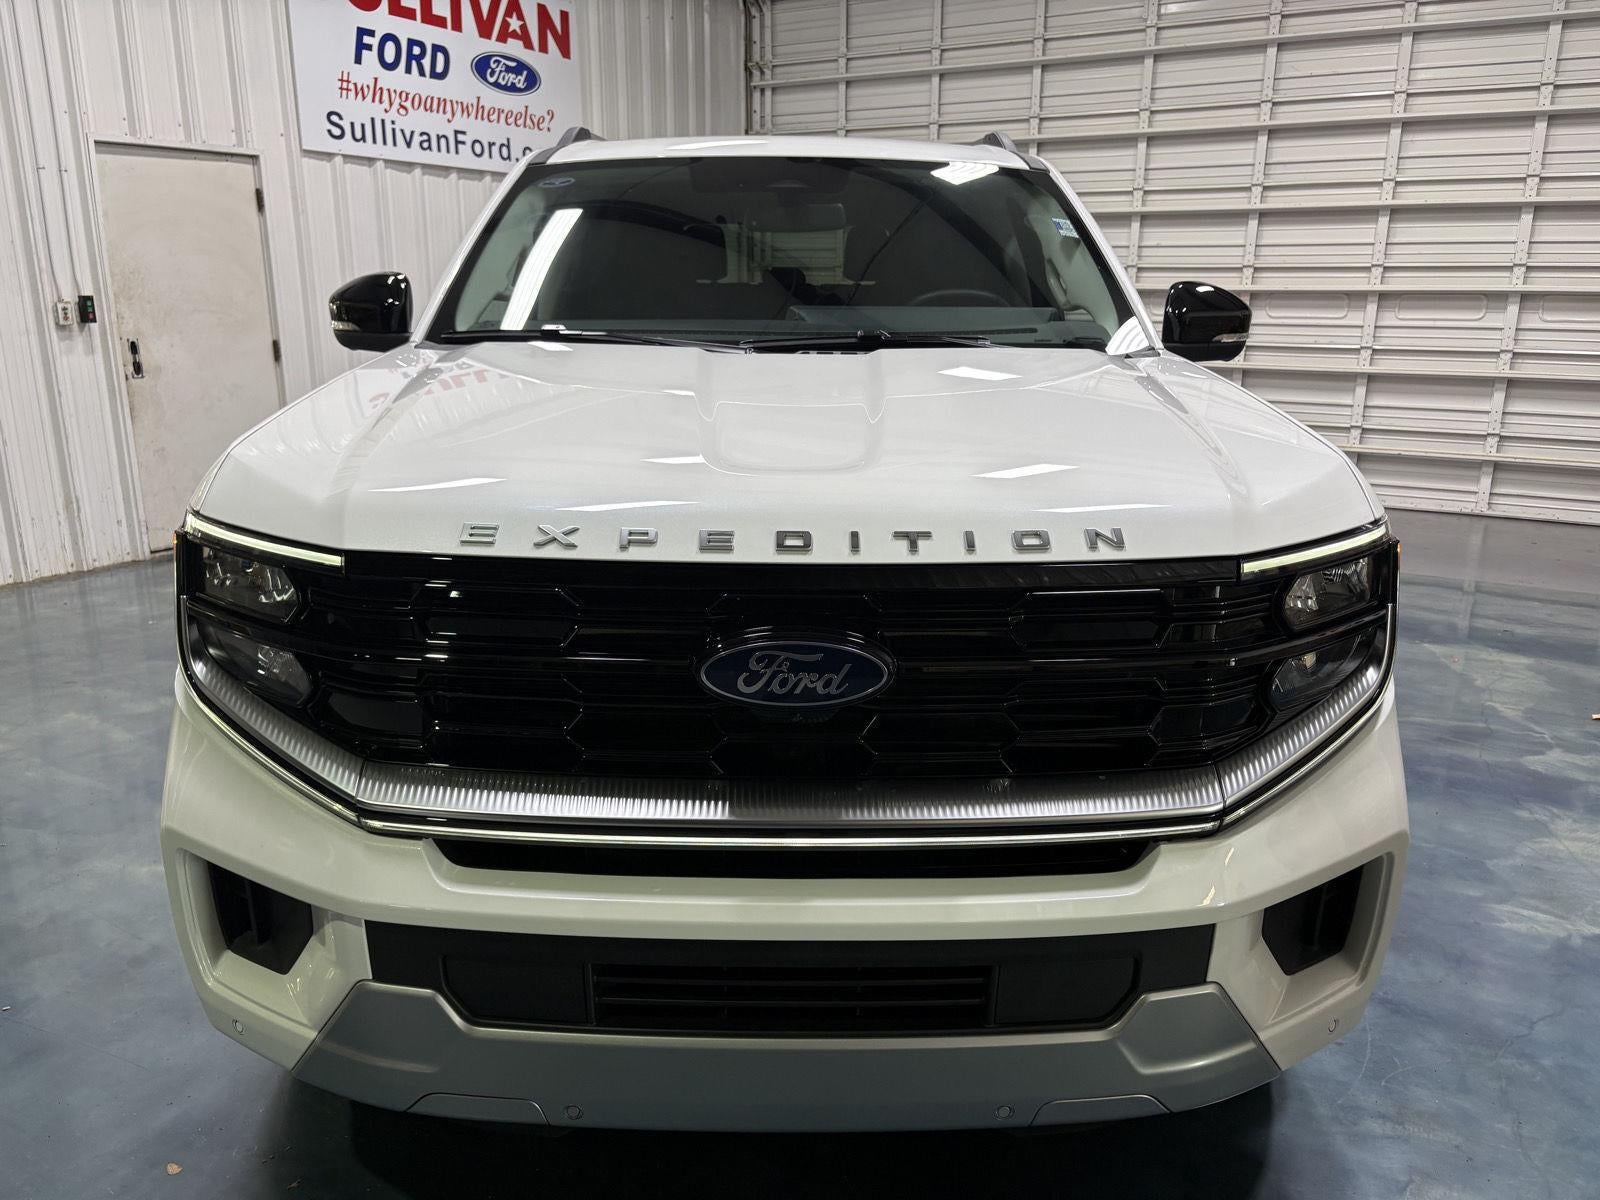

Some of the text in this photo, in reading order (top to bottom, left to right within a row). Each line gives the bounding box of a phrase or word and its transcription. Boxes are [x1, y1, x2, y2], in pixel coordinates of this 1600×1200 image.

[353, 26, 450, 81] FORD
[486, 56, 527, 88] Ford
[337, 70, 554, 132] #whygoanywhereelse?
[460, 522, 1126, 552] EXPEDITION
[736, 651, 852, 695] Ford
